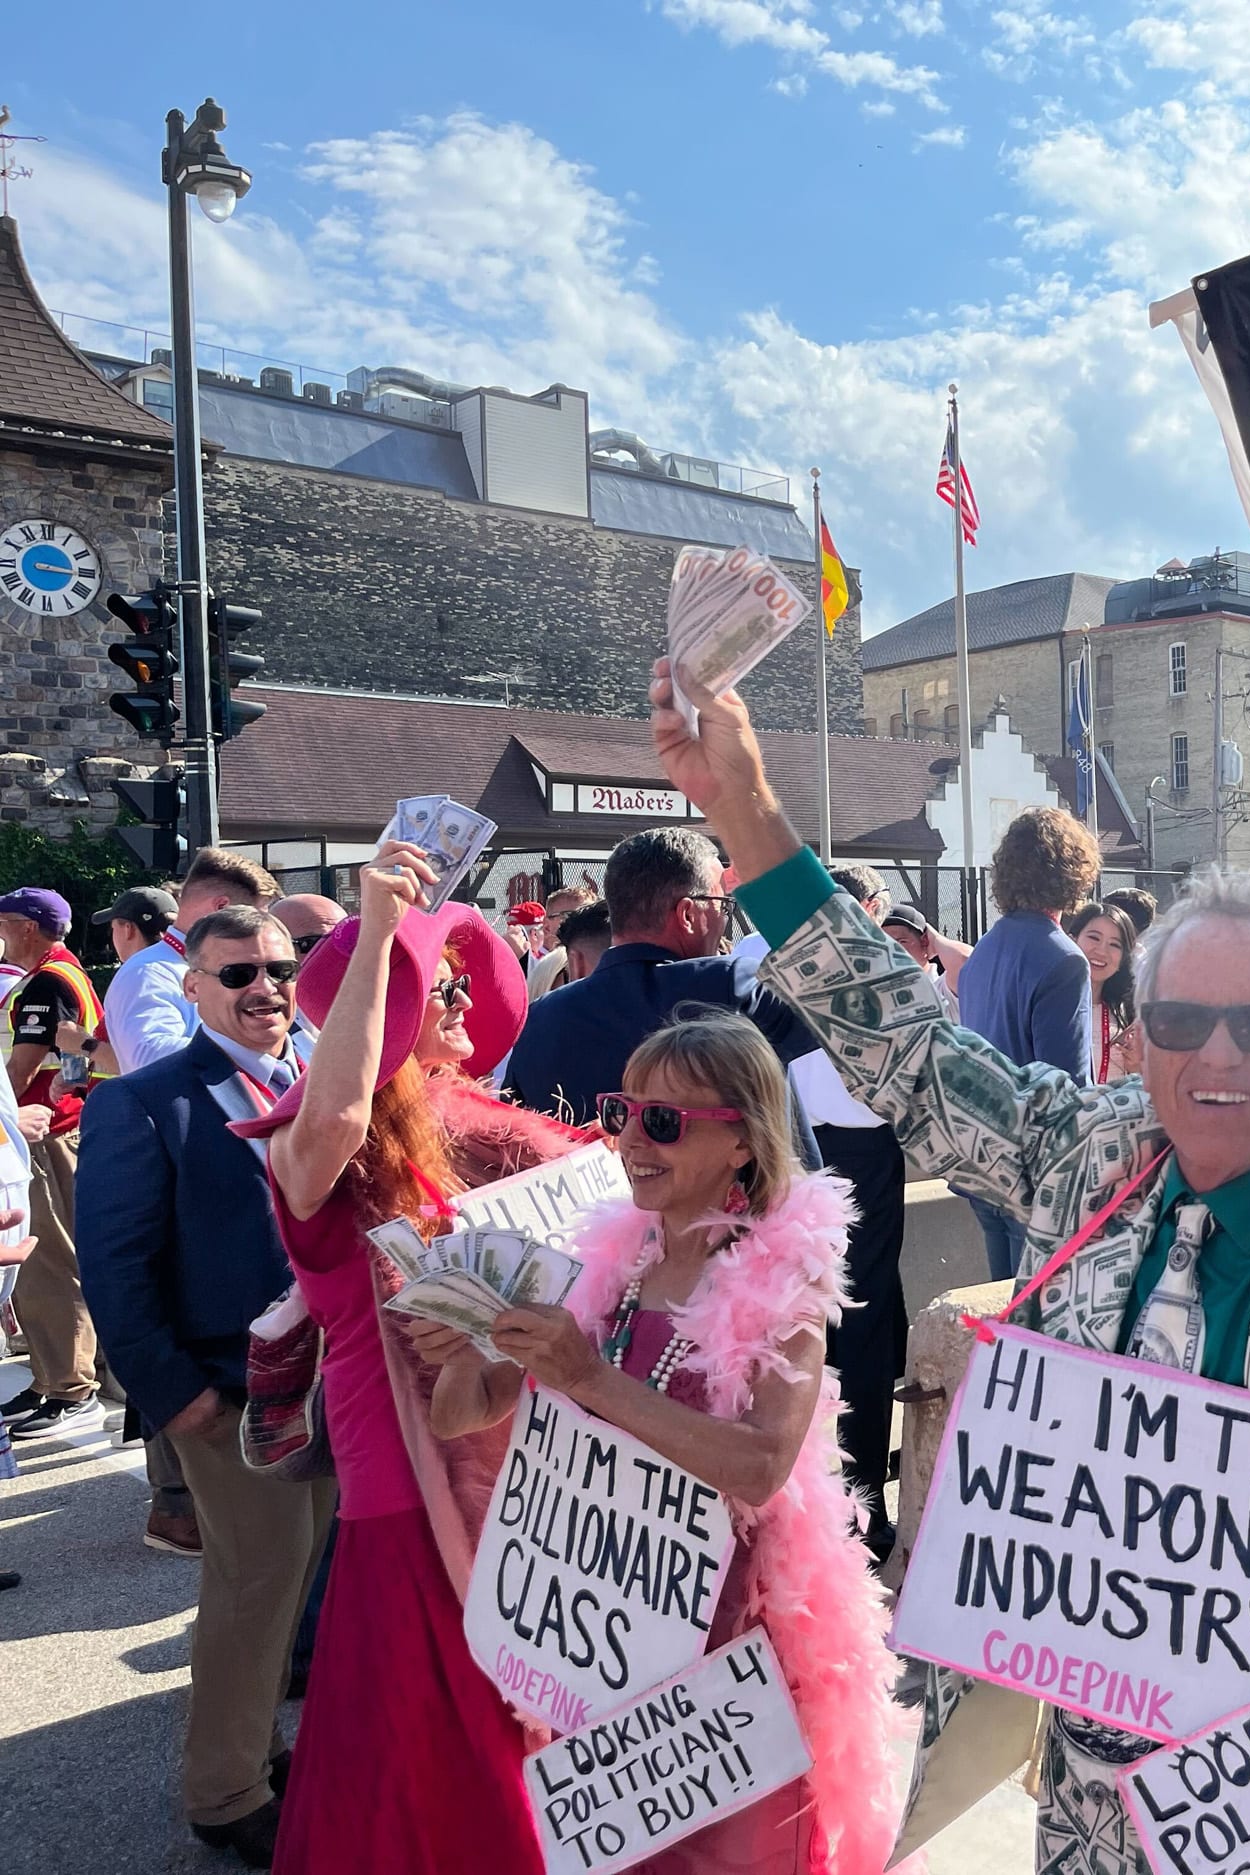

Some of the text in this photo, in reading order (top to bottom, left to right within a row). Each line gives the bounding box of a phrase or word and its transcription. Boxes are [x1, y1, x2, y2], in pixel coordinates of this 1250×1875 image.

[753, 575, 797, 620] 100
[592, 787, 674, 811] Mader's
[524, 1173, 580, 1232] I'M
[576, 1153, 618, 1202] THE
[1094, 1377, 1179, 1463] I'M
[566, 1429, 617, 1498] I'M
[634, 1458, 719, 1542] THE
[498, 1448, 720, 1633] BILLIONAIRE
[496, 1537, 633, 1691] CLASS
[495, 1643, 593, 1727] CODEPINK
[535, 1652, 768, 1797] LOOKING 4
[983, 1629, 1174, 1730] CODEPINK
[544, 1699, 755, 1841] POLITICIANS
[562, 1744, 755, 1869] TO BUY!!
